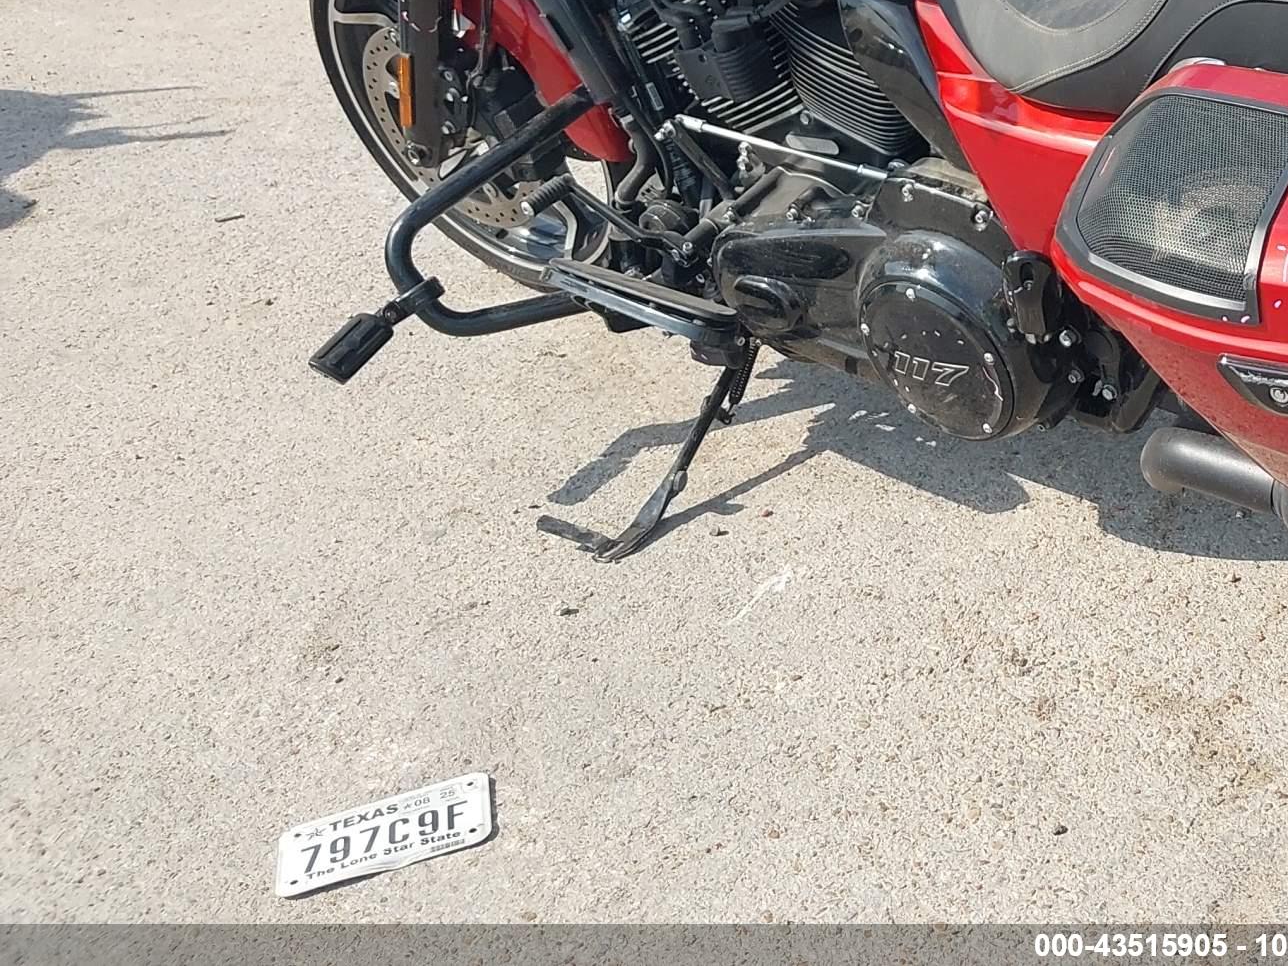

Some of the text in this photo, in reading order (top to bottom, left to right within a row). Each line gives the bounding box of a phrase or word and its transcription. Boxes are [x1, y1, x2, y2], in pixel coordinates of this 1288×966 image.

[894, 350, 970, 387] 117
[301, 799, 468, 874] 797C9F
[329, 803, 399, 831] TEXAS
[305, 867, 335, 880] The
[340, 853, 378, 869] Lone
[383, 841, 415, 856] Star
[420, 831, 461, 846] State
